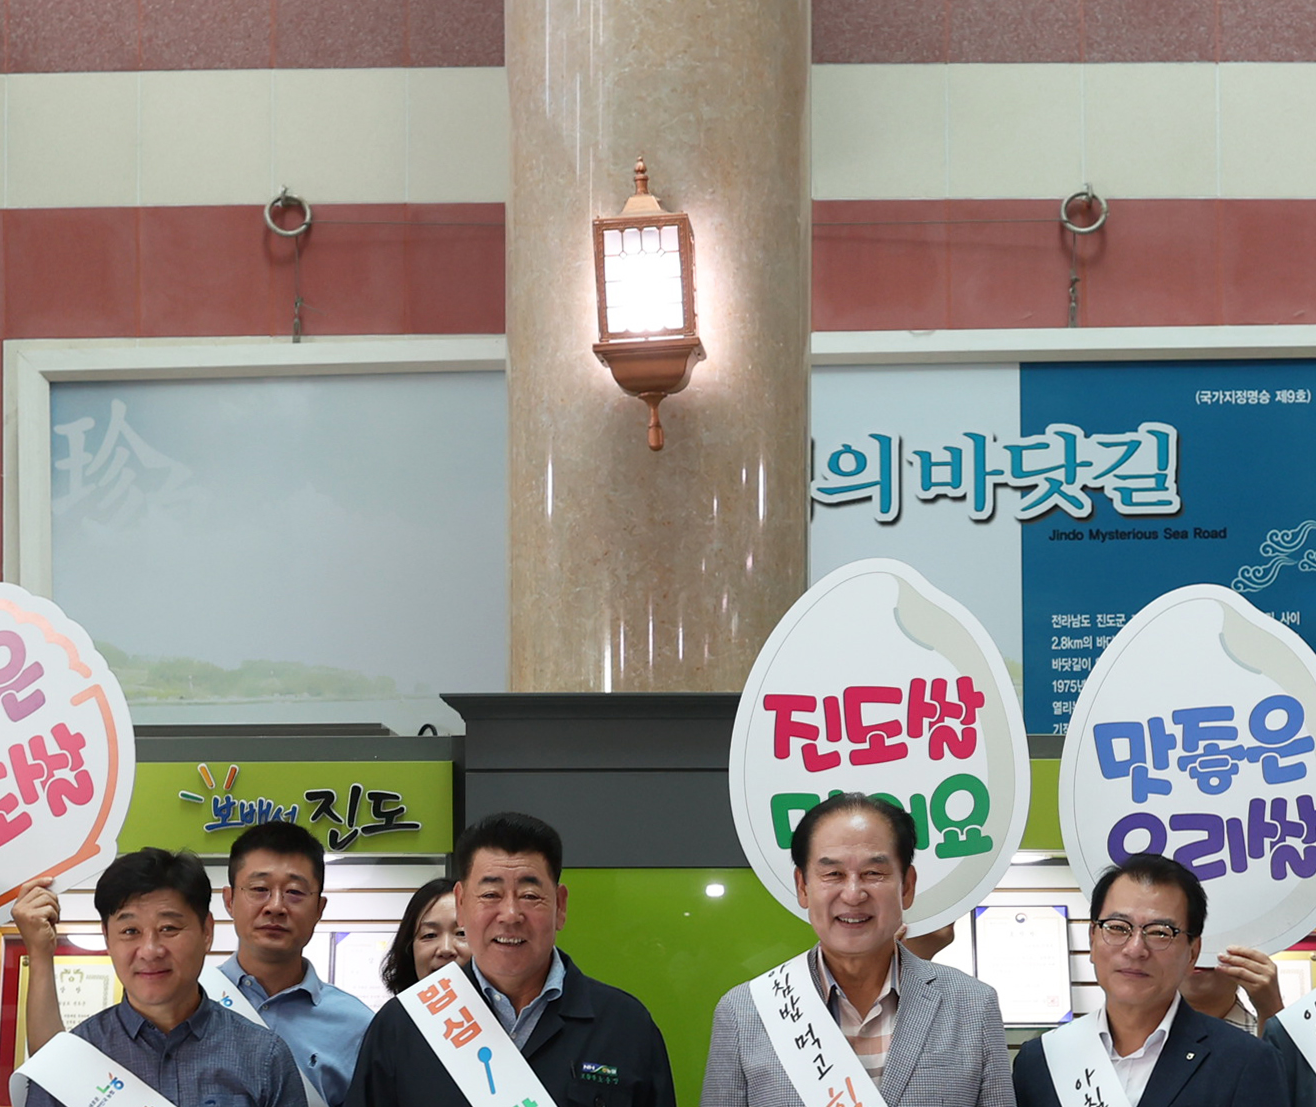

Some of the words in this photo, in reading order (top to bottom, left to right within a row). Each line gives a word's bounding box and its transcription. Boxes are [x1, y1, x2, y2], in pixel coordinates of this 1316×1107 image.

[1196, 388, 1271, 406] (국가지정명승
[1275, 387, 1312, 405] 제9호)
[913, 427, 1175, 515] 바닷길
[1048, 527, 1084, 543] Jindo
[1089, 526, 1159, 544] Mysterious
[1163, 526, 1189, 542] Sea
[1193, 525, 1227, 541] Road
[1051, 613, 1091, 628] 전라남도
[1051, 635, 1093, 650] 2.8km의
[1051, 656, 1091, 672] 바닷길이
[763, 676, 985, 773] 진도쌀
[1093, 694, 1315, 804] 맛좋은
[305, 783, 421, 851] 진도
[417, 977, 483, 1048] 밥심
[794, 1023, 834, 1081] 먹고
